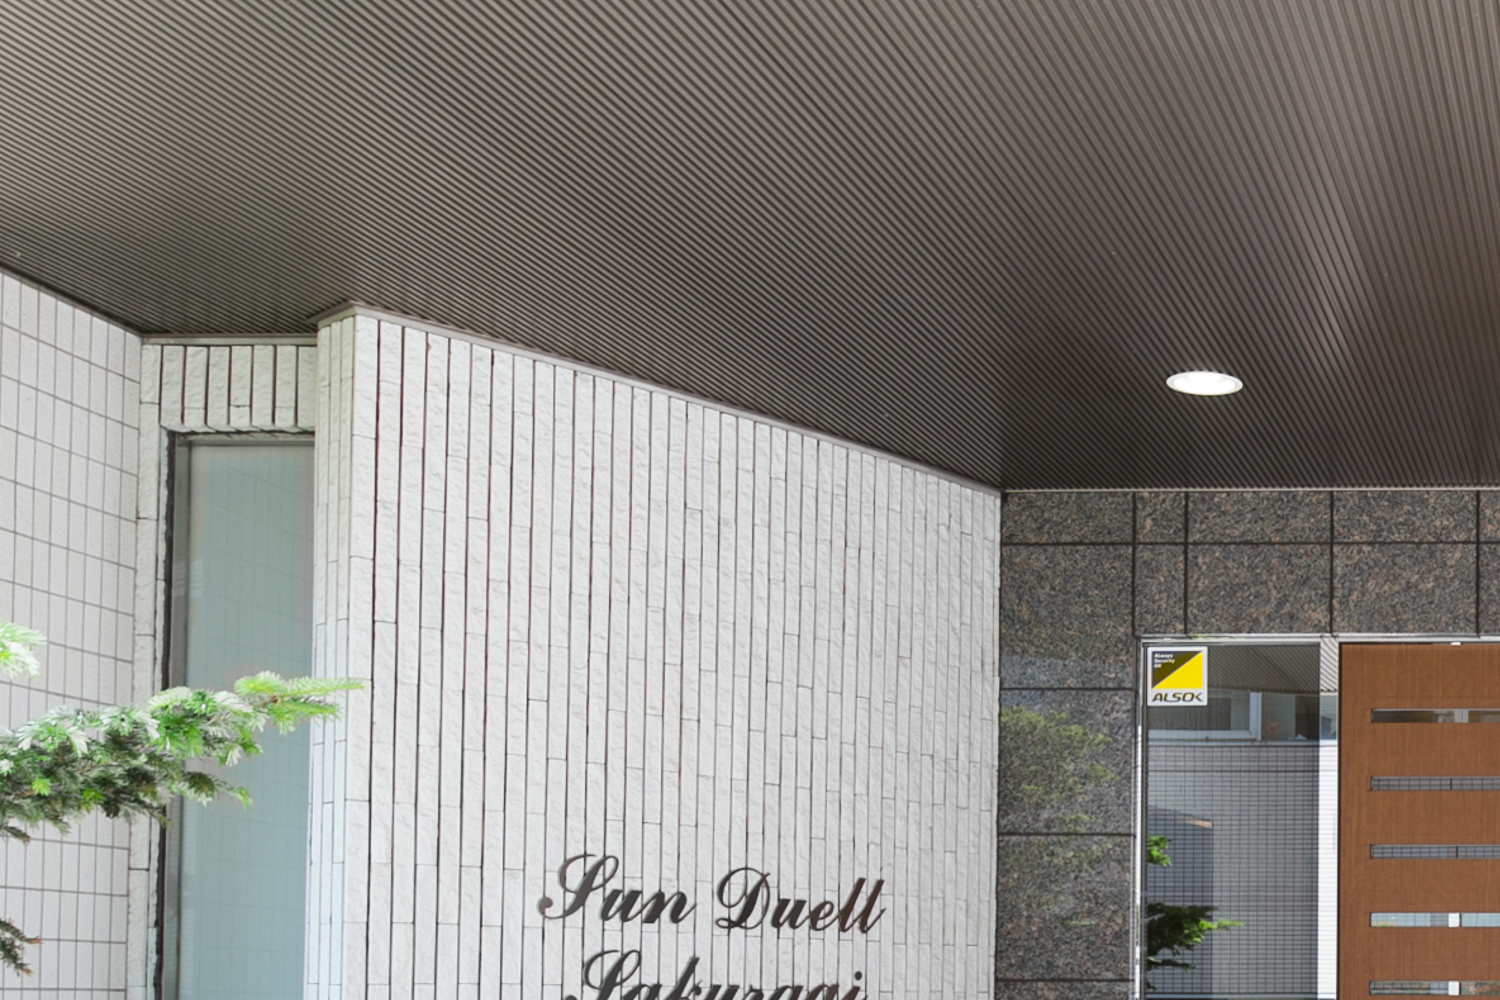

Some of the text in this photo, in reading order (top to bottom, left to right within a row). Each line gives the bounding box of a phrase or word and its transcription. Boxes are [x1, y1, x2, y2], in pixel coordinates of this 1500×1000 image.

[1151, 692, 1203, 702] ALSOK
[538, 853, 886, 934] Sun Duell
